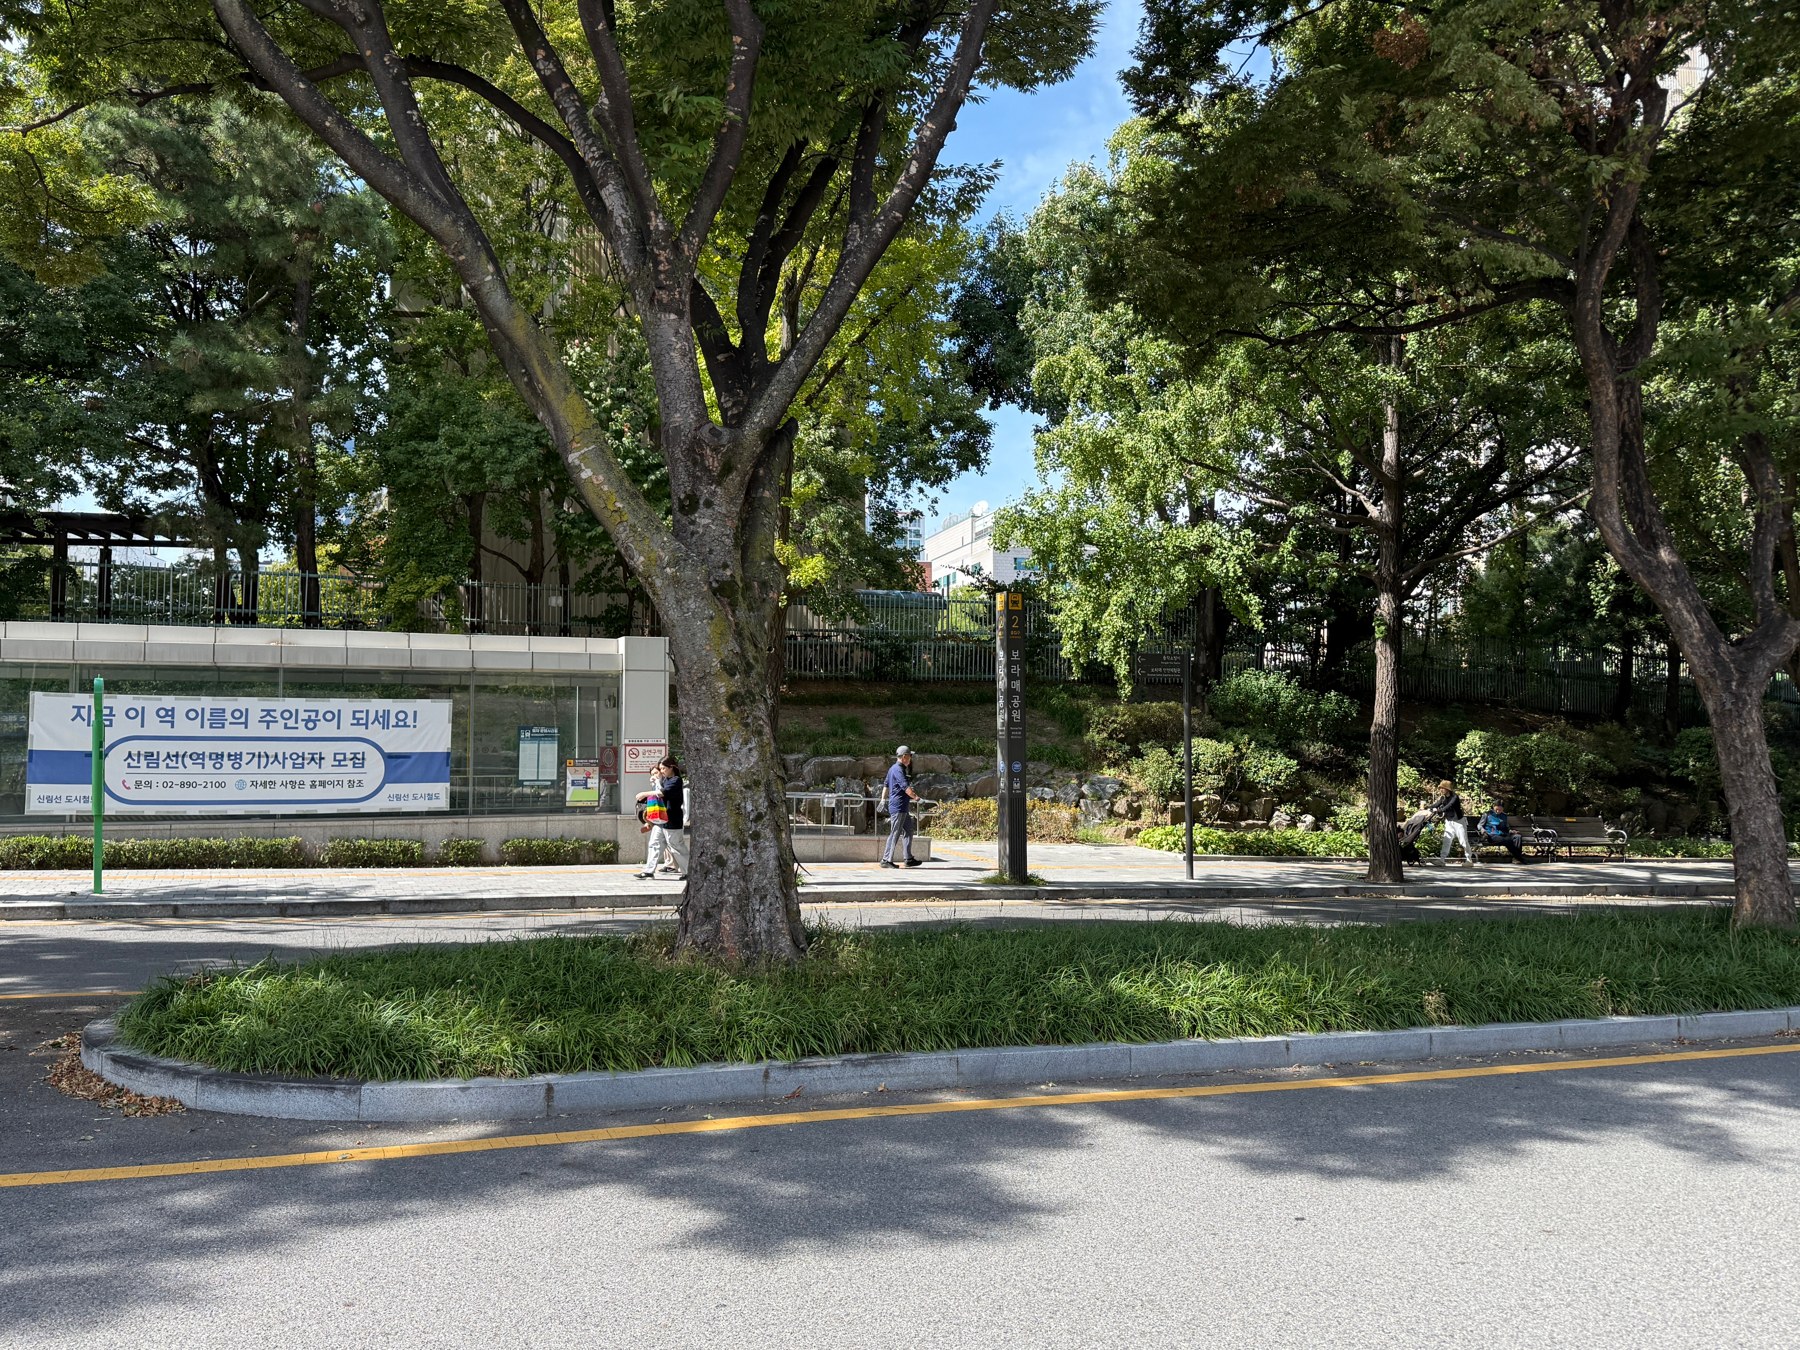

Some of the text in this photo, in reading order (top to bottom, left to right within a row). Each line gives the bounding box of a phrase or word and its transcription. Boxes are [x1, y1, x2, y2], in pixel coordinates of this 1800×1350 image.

[1011, 615, 1019, 628] 2
[1010, 650, 1021, 722] 보라매공원
[70, 704, 418, 731] 지금 이 역 이름의 주인공이 되세요!
[123, 750, 366, 770] 신림선(역명병기)사업자 모집
[133, 780, 153, 790] 문의
[162, 780, 227, 789] 02-890-2100
[249, 779, 364, 790] 자세한 사항은 홈페이지 참조
[36, 795, 93, 804] 신림선 도시철
[387, 792, 441, 802] 신림선 도시철도
